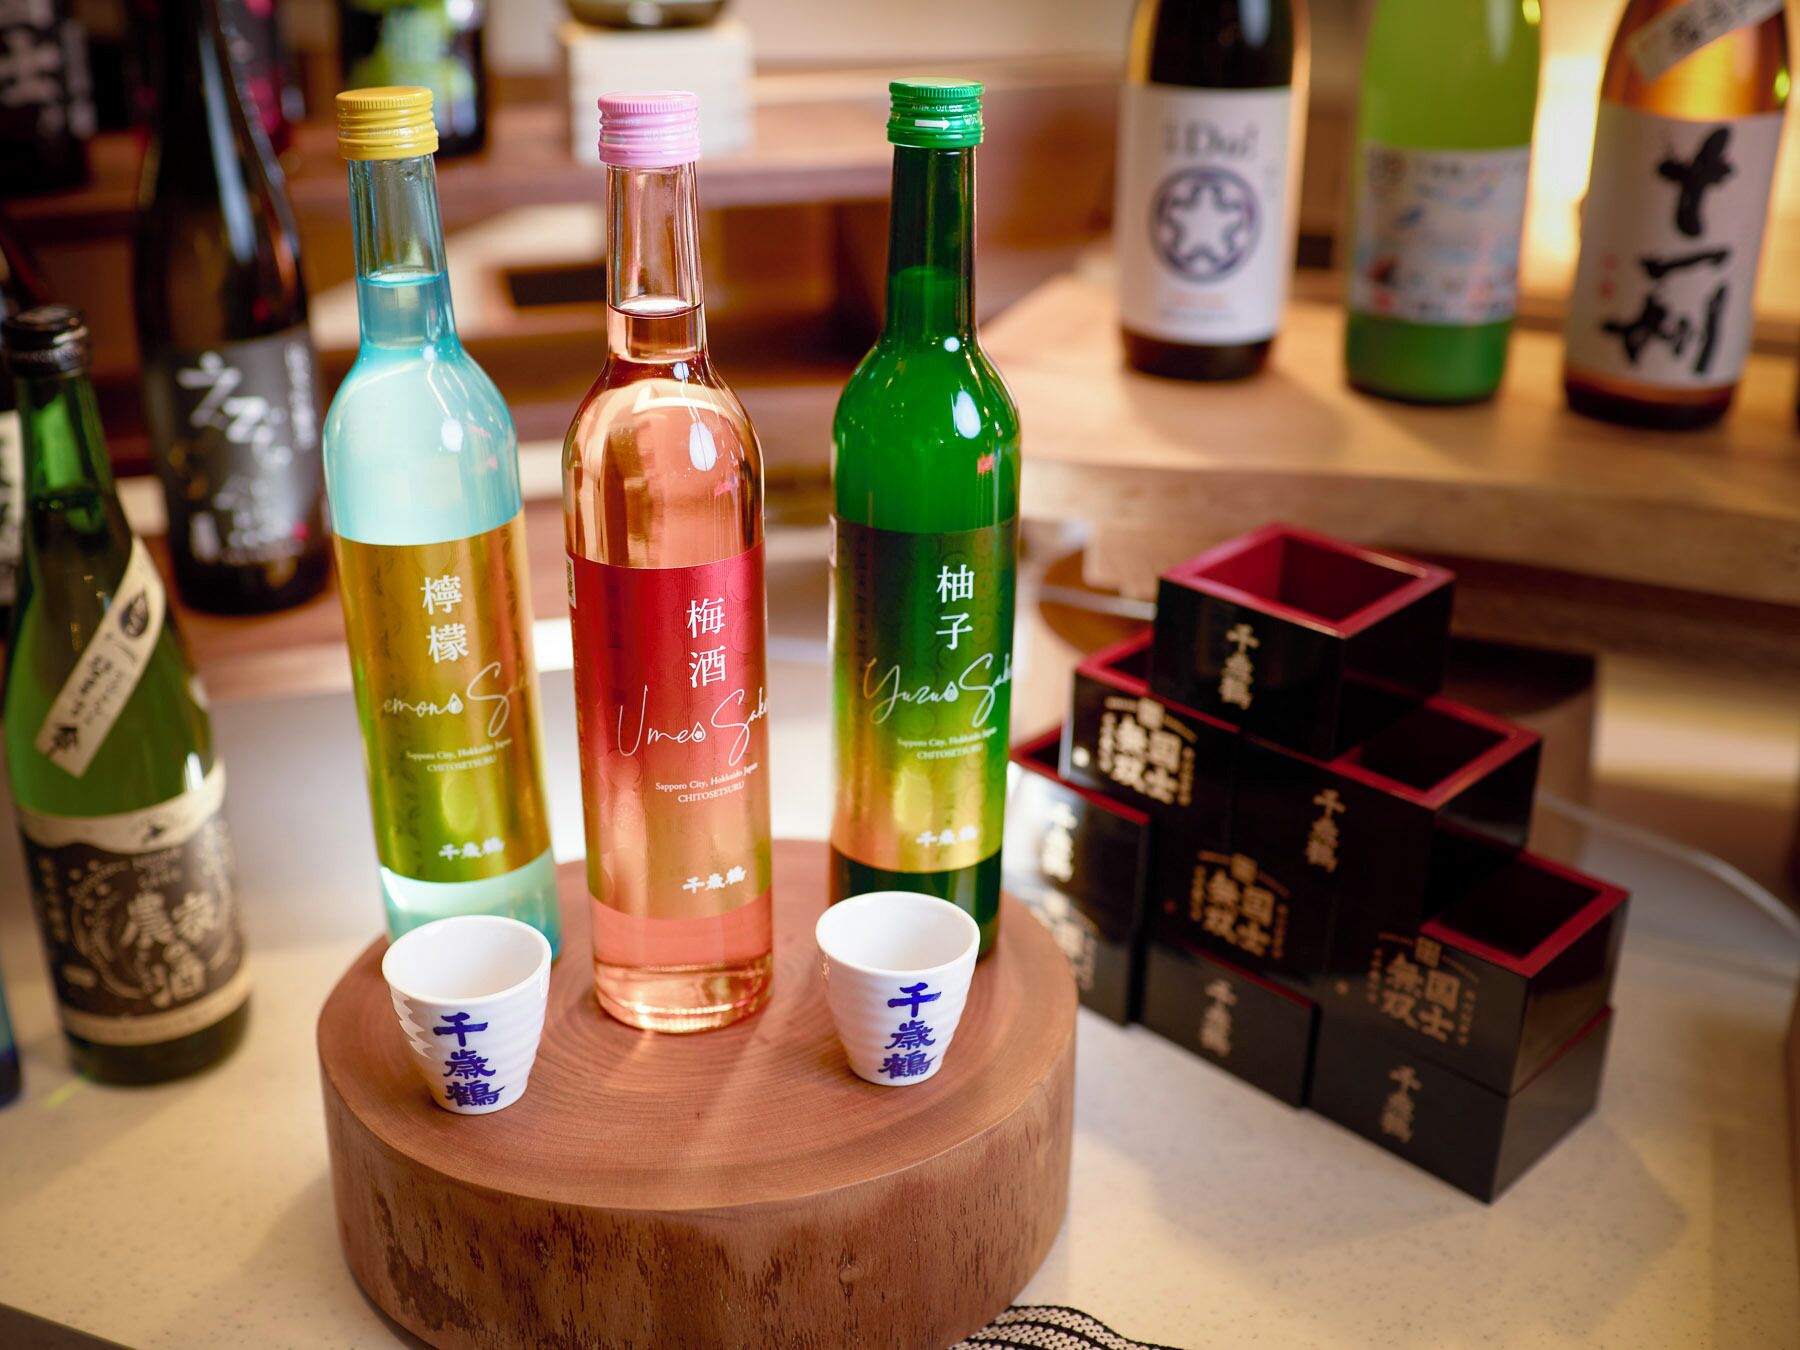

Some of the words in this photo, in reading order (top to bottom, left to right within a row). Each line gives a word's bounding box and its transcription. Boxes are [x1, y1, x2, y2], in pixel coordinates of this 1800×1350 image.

[420, 575, 469, 664] 檸檬
[686, 597, 726, 688] 梅酒
[936, 564, 975, 650] 柚子
[383, 697, 448, 718] emon
[655, 782, 687, 793] Sapporo
[689, 779, 708, 790] City,
[710, 770, 743, 785] Hokkaido
[677, 781, 745, 804] CHITOSETSURU
[433, 1012, 505, 1107] 千歳鶴
[878, 982, 942, 1079] 千歳鶴
